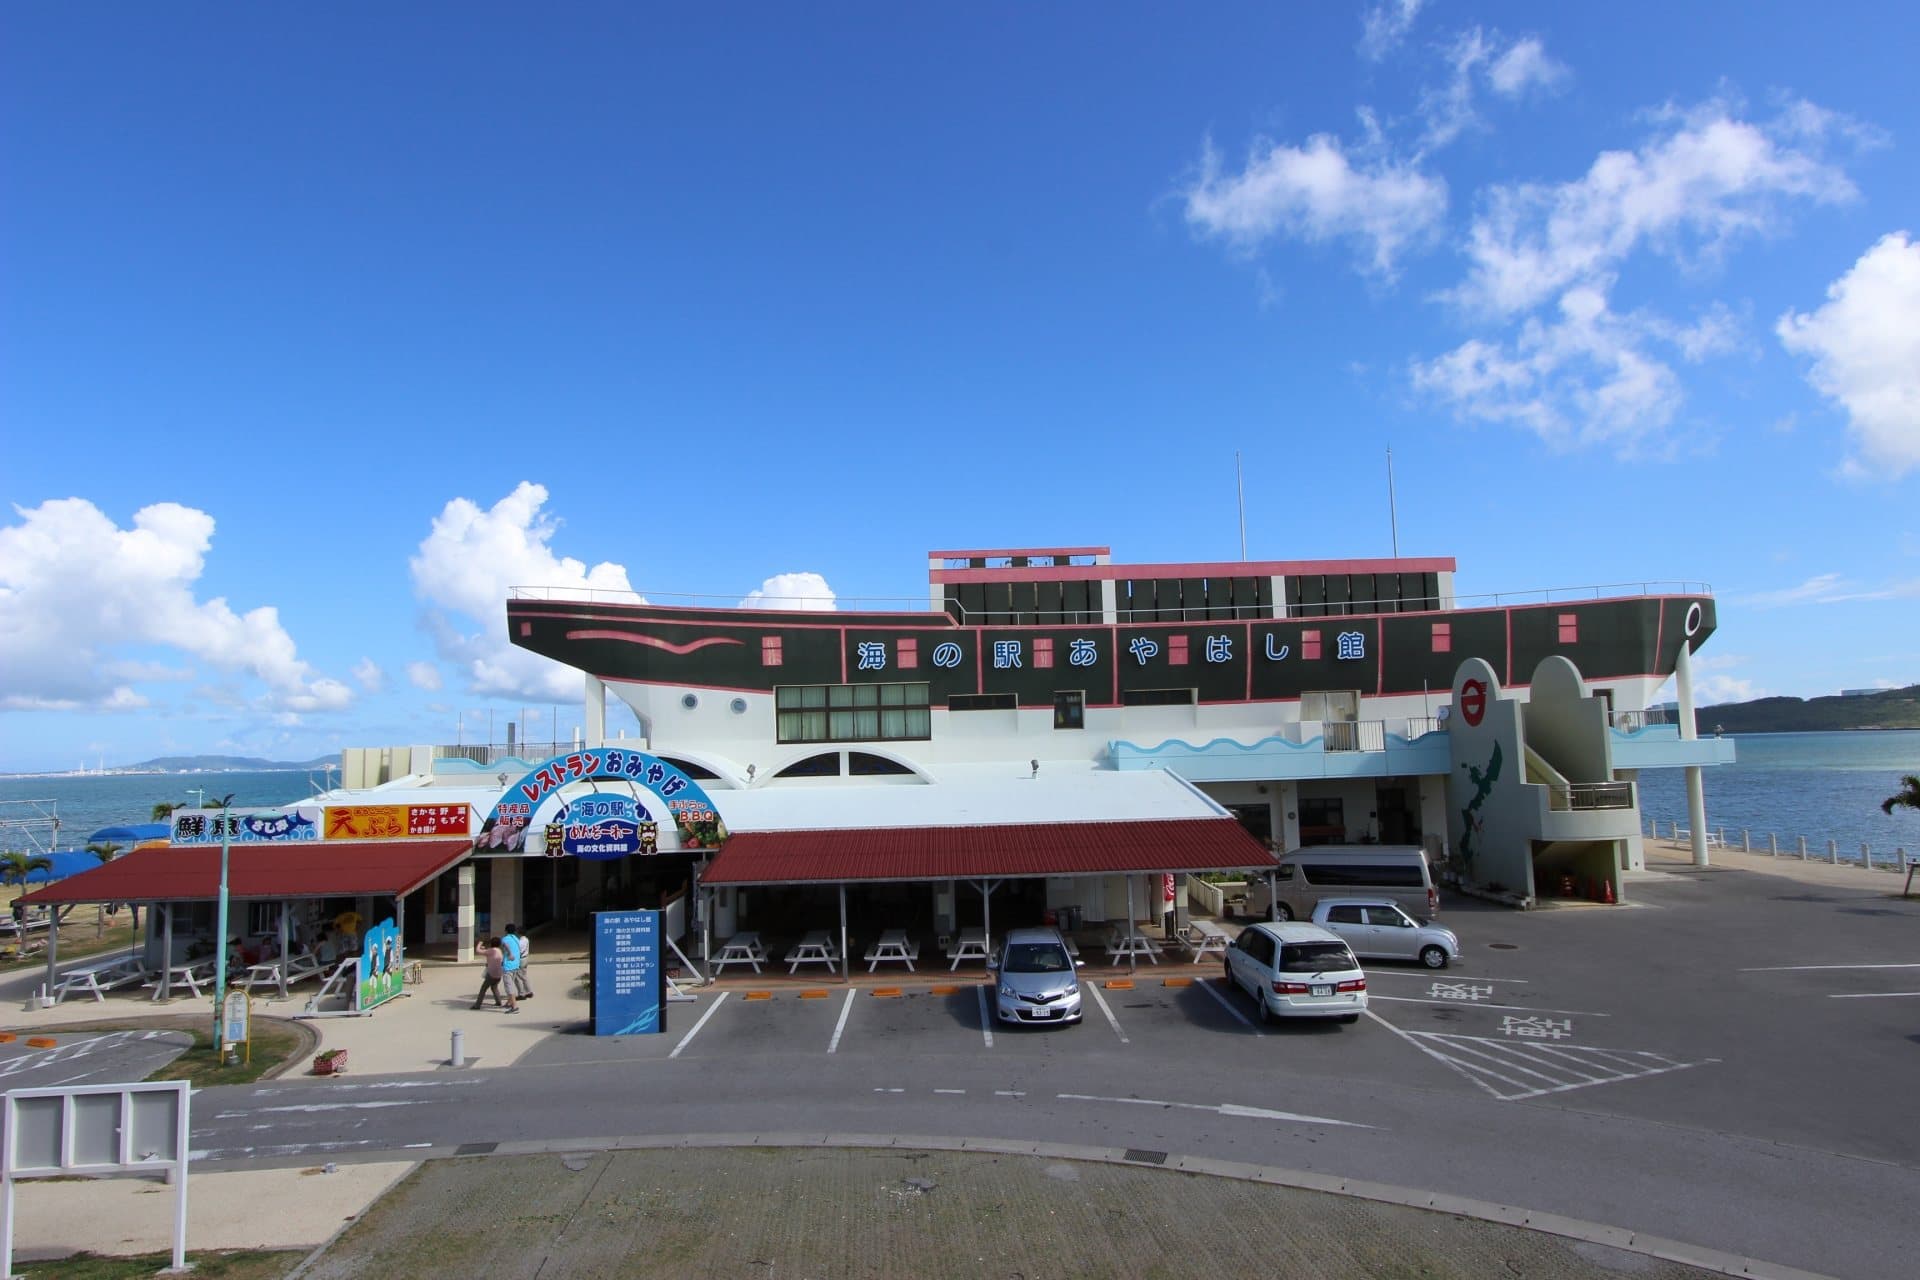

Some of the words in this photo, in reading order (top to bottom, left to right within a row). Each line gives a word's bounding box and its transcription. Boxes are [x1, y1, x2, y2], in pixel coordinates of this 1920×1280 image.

[521, 753, 600, 802] レストラン
[605, 751, 687, 796] おみやげ
[411, 807, 436, 816] さかな
[498, 803, 530, 814] 特産品
[581, 801, 624, 817] 海の駅
[177, 814, 240, 837] 鮮魚
[251, 818, 289, 833] さしみ
[328, 808, 403, 837] 天ぷら
[440, 815, 465, 824] もずく
[499, 816, 525, 826] 販売
[569, 824, 633, 840] めんそーれー
